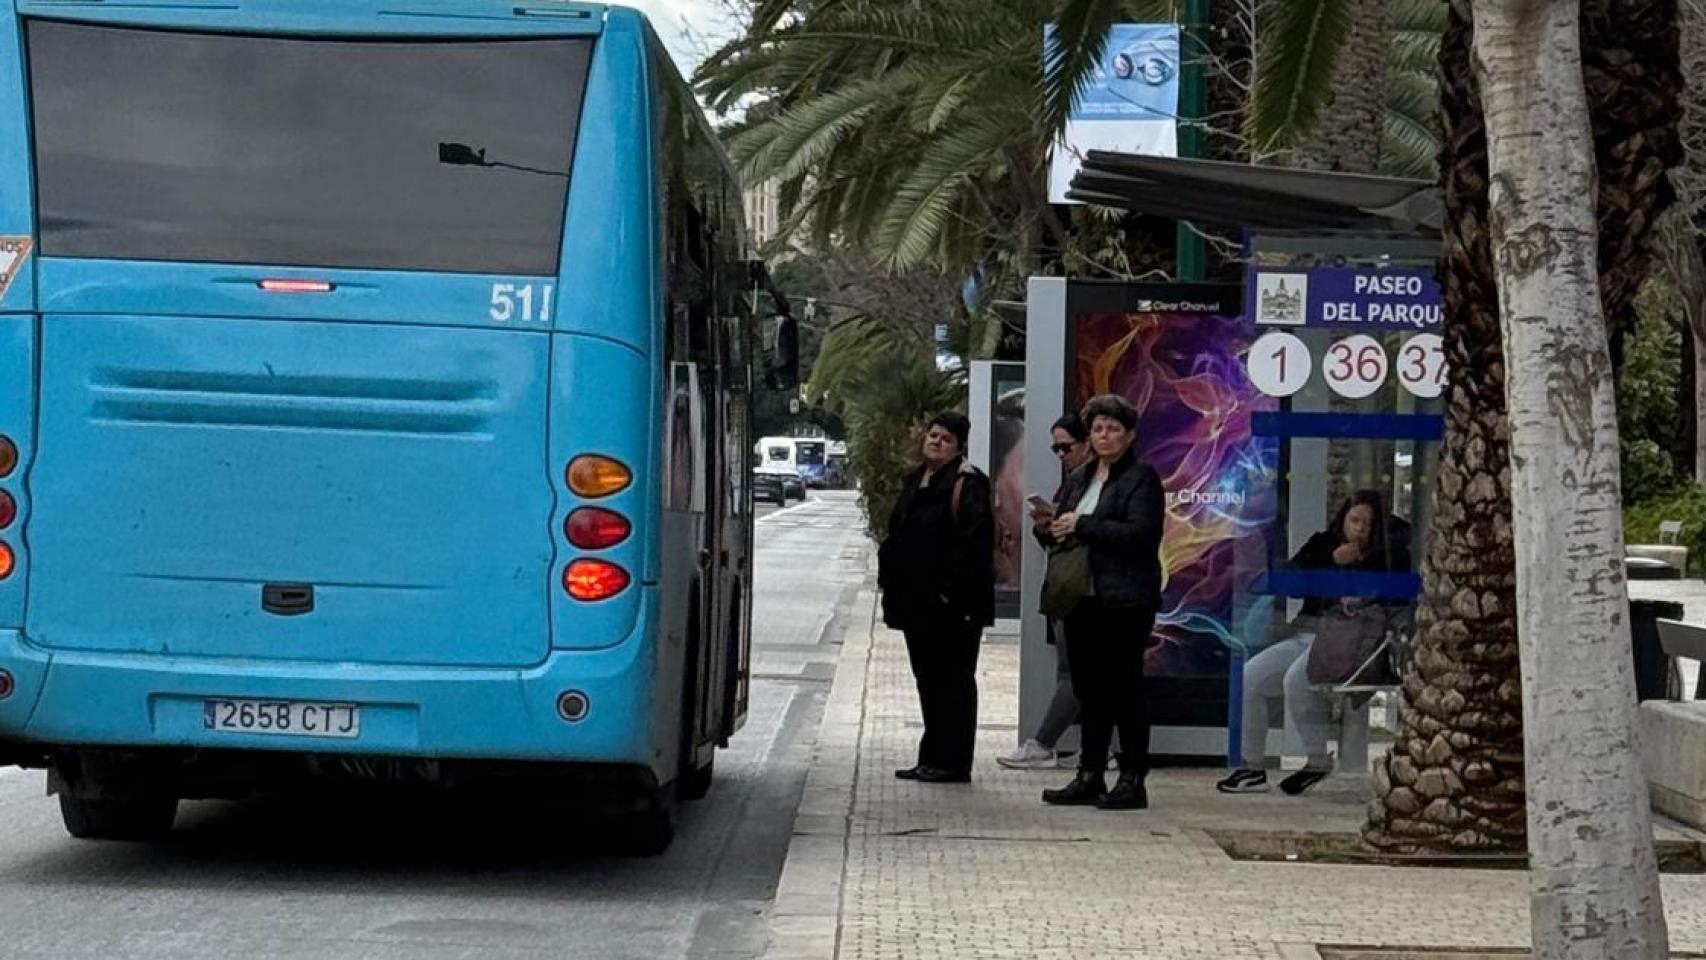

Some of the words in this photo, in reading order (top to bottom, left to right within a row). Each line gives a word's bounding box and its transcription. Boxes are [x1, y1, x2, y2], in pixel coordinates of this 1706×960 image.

[1354, 275, 1423, 296] PASEO
[1153, 300, 1179, 311] Clear
[1323, 302, 1362, 322] DEL
[1367, 303, 1444, 328] PARQU
[1271, 345, 1287, 383] 1
[1329, 343, 1381, 383] 36
[1403, 344, 1446, 385] 37
[1177, 489, 1246, 504] Channel
[221, 702, 291, 731] 2658
[302, 705, 355, 734] CTJ
